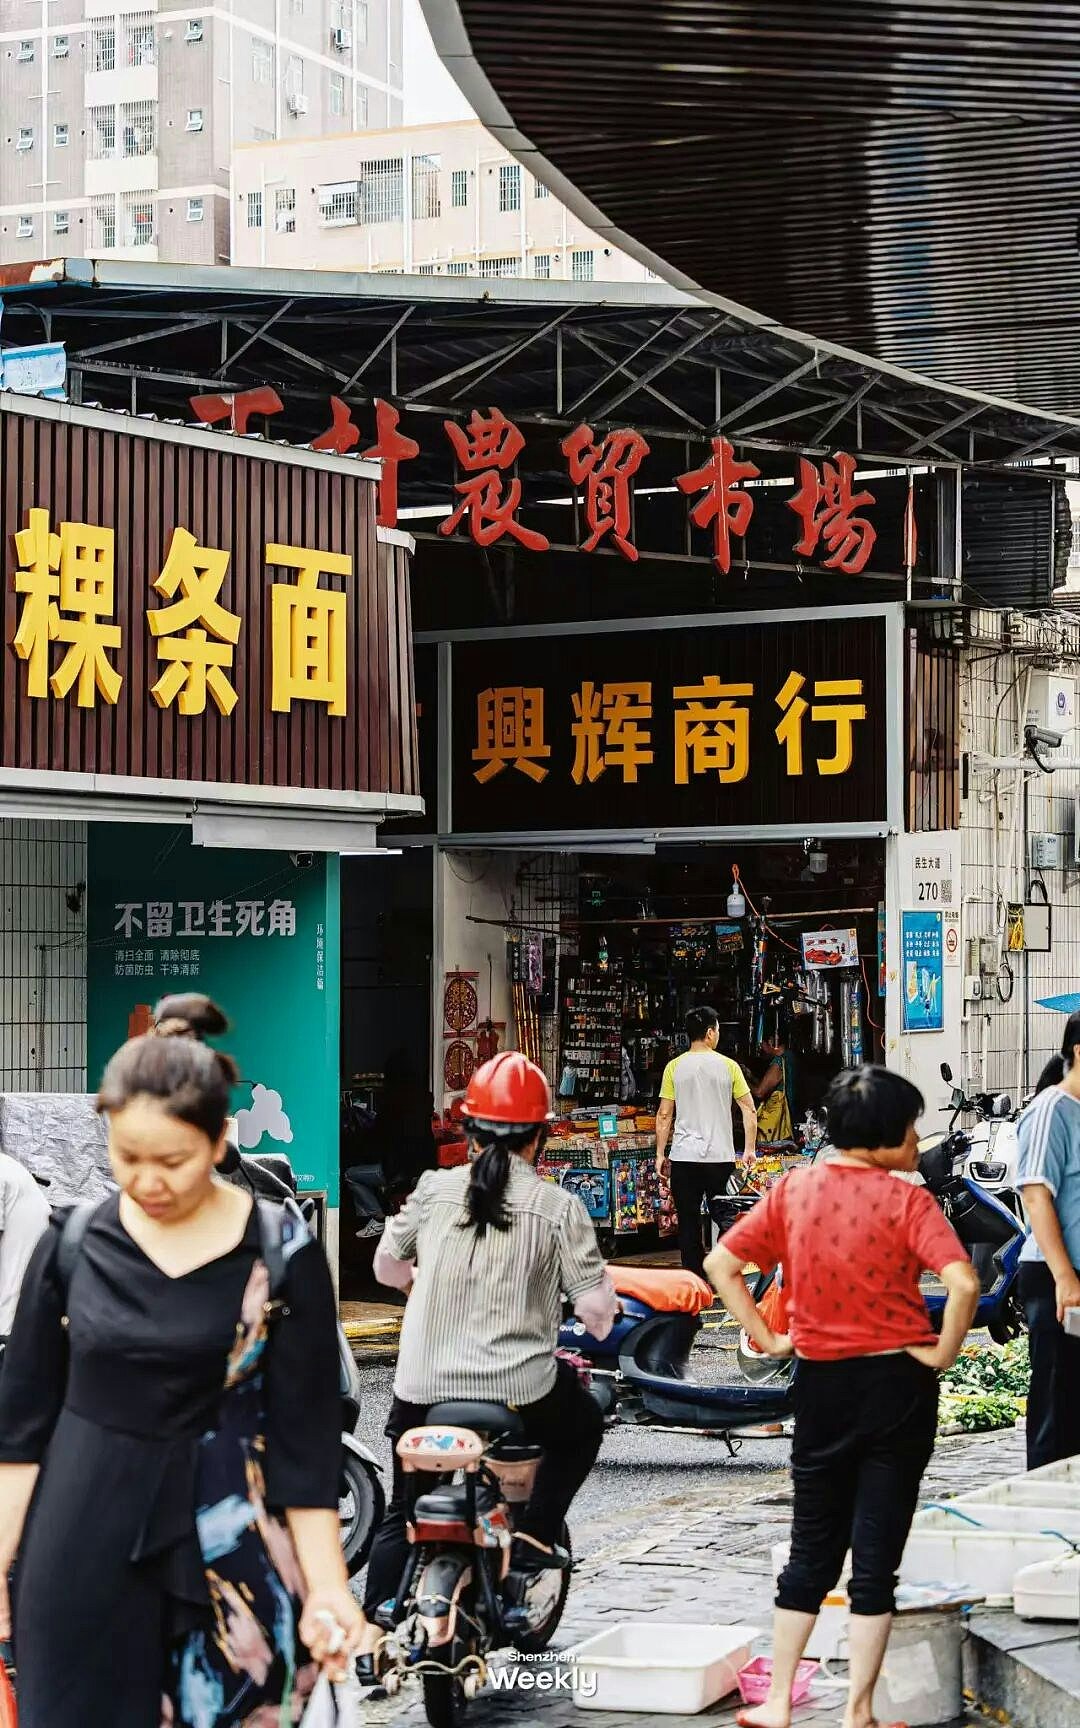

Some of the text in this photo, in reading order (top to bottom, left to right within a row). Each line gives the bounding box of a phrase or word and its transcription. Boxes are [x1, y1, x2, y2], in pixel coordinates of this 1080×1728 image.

[13, 507, 353, 718] 粿条面
[471, 669, 866, 785] 興辉商行
[915, 857, 941, 869] 民生大道
[918, 882, 939, 901] 270
[114, 899, 296, 938] 不留卫生死角
[115, 948, 154, 961] 清扫全面
[114, 963, 200, 976] 防菌防虫 干净清新
